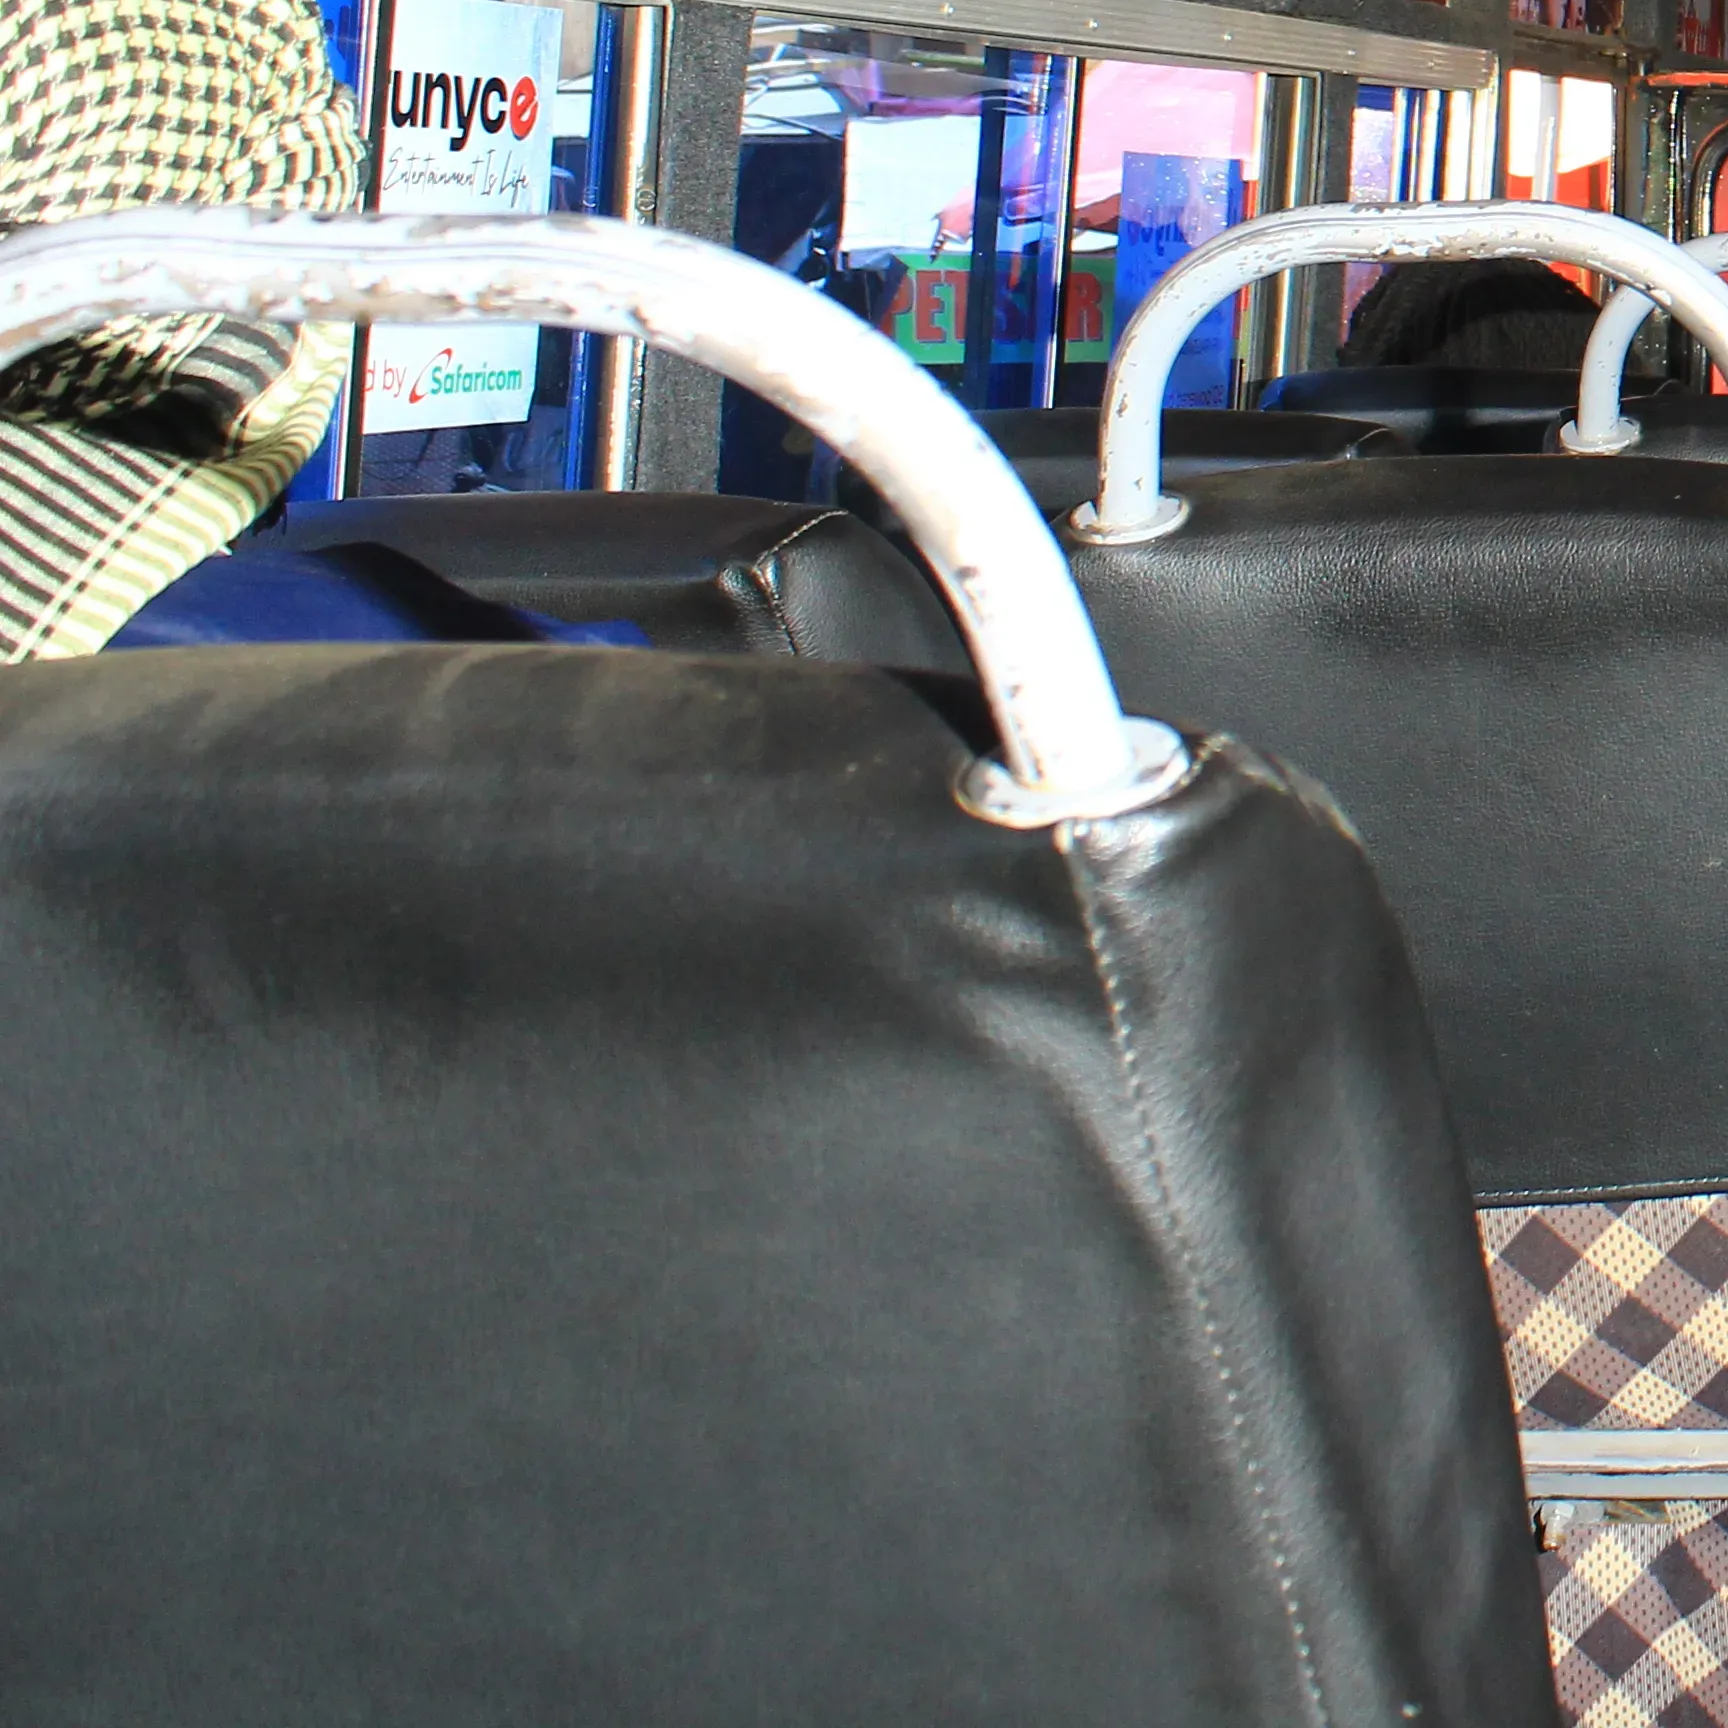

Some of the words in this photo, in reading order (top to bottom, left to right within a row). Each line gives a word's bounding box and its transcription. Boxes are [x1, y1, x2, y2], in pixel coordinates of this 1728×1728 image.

[388, 69, 539, 152] unyce
[383, 146, 485, 197] Entertainment
[498, 149, 530, 209] Life
[382, 358, 408, 398] by
[429, 362, 523, 397] Safaricom
